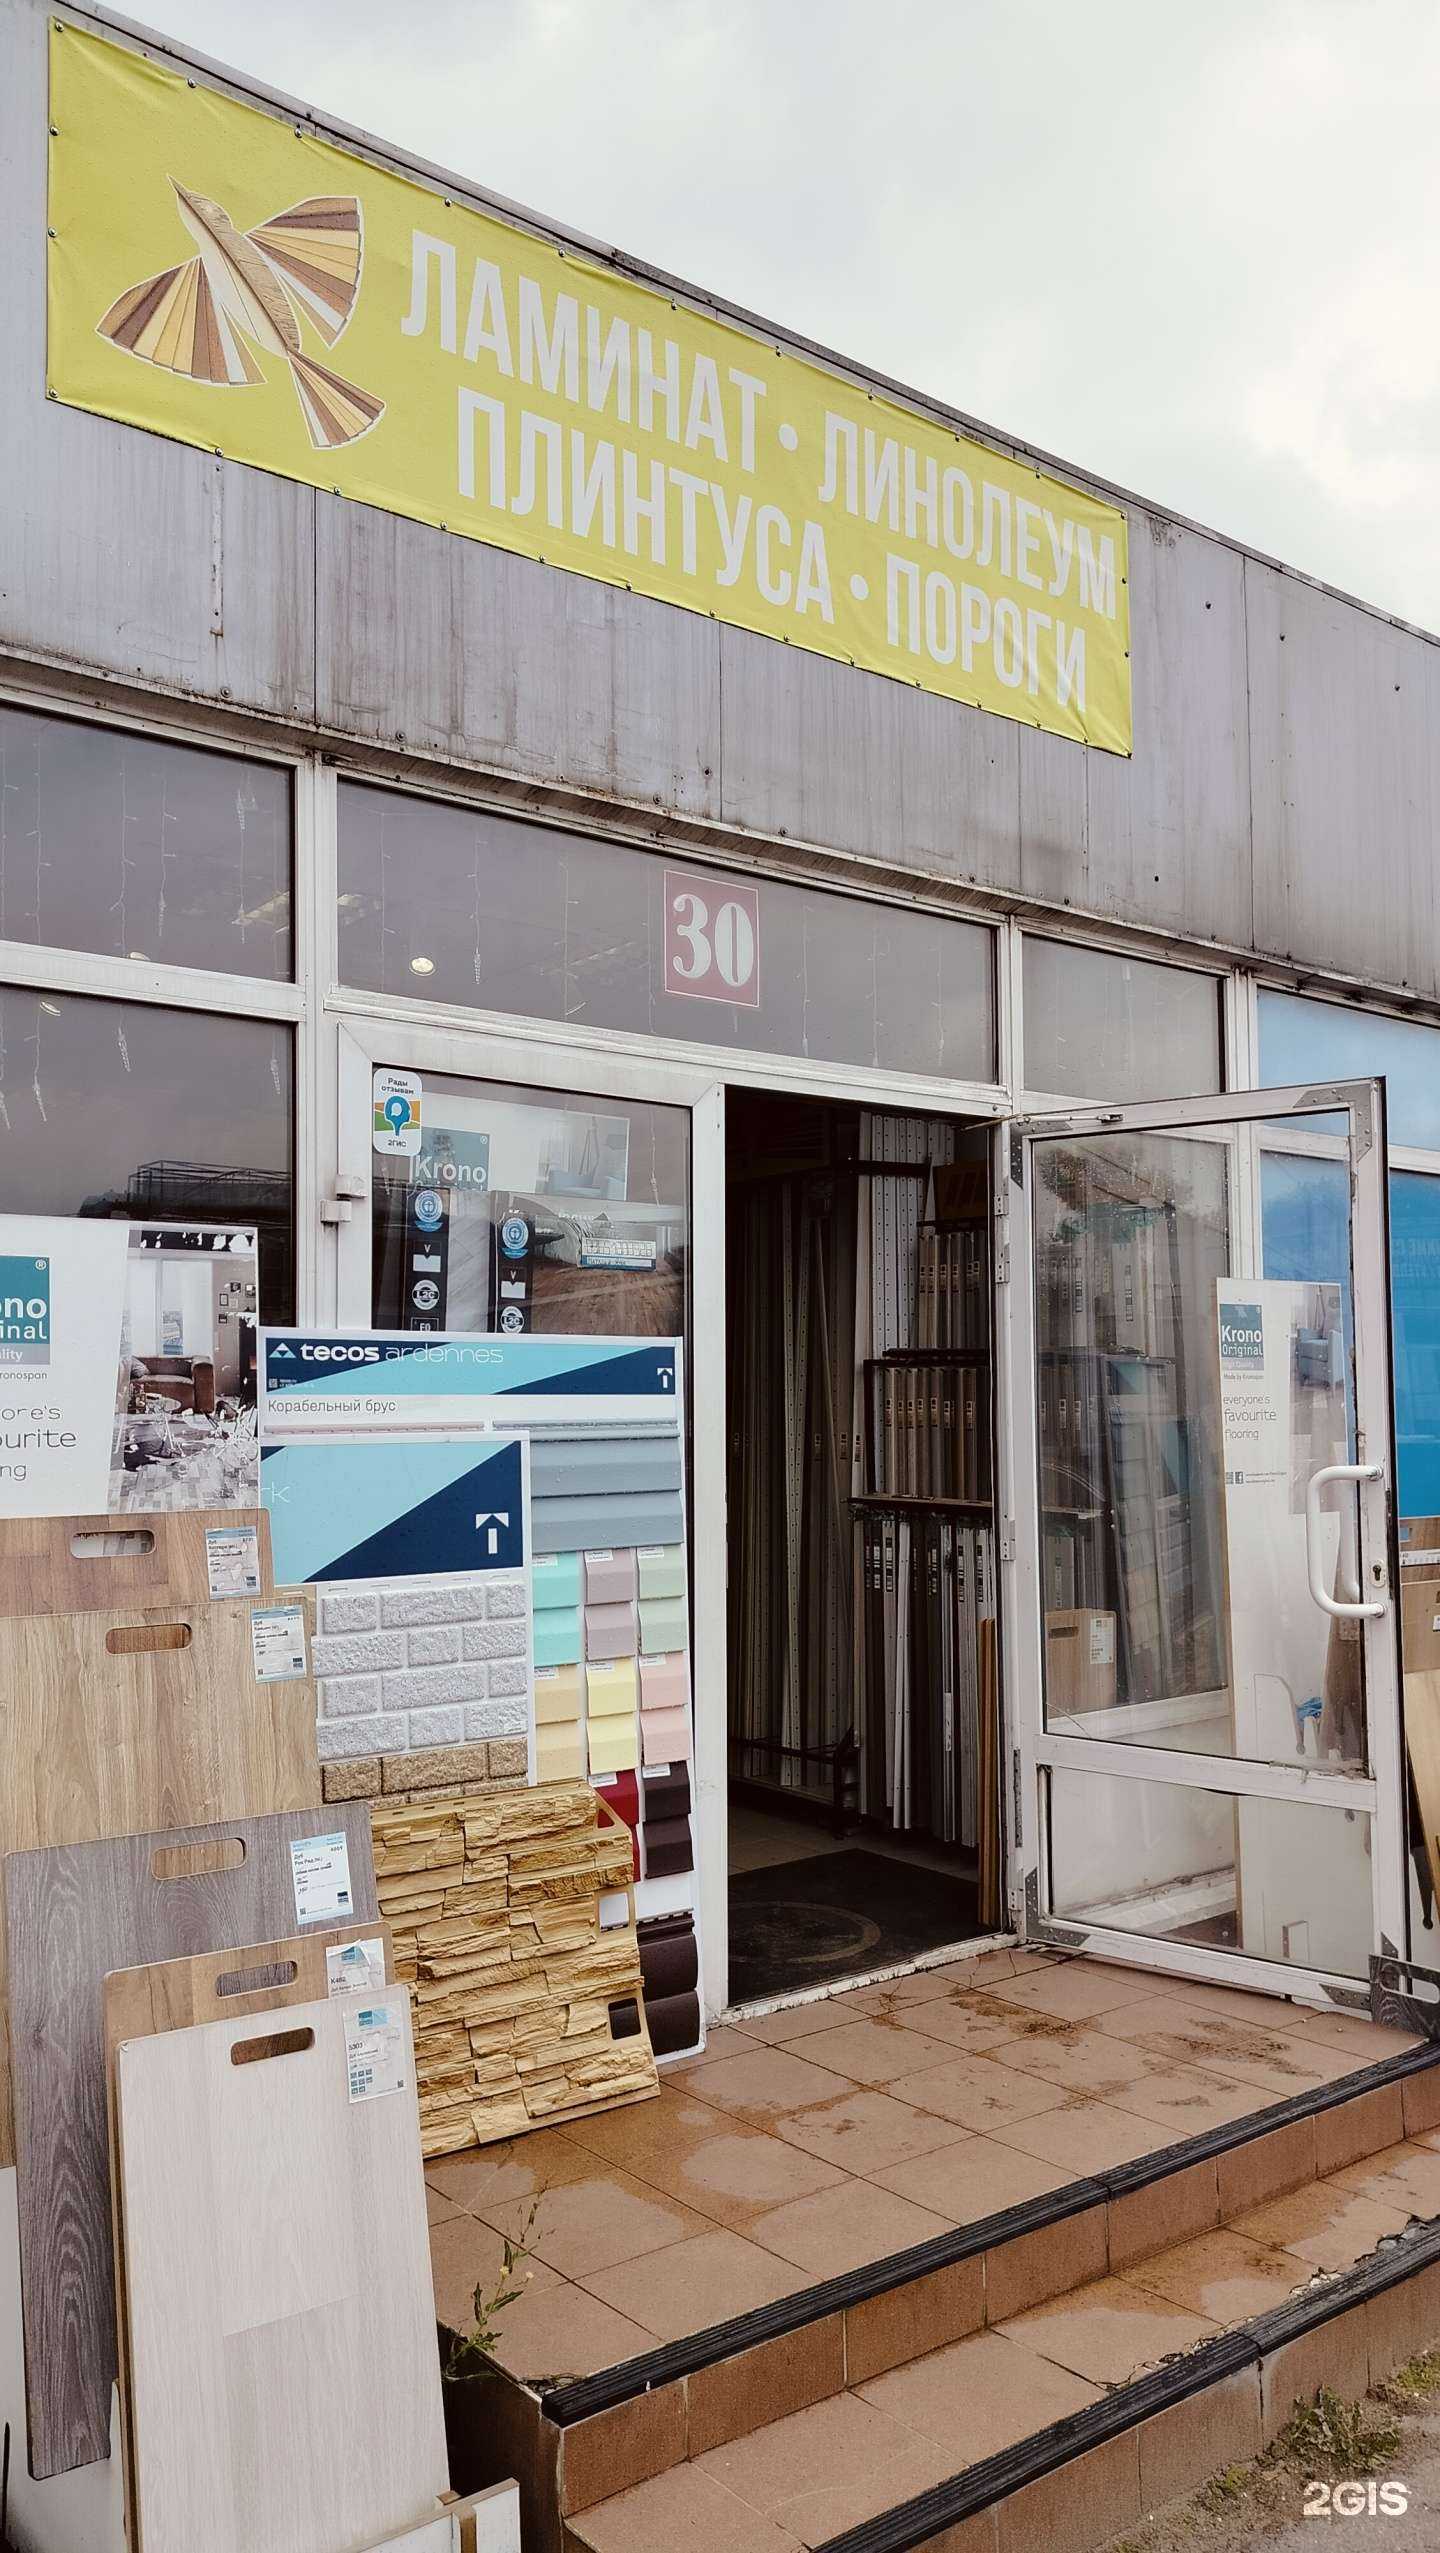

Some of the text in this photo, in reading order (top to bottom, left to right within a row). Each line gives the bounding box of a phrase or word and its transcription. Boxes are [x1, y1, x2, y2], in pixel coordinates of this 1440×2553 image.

[400, 229, 1116, 621] ЛАМИНАТ ЛИНОЛЕУМ
[457, 385, 1087, 713] ПЛИНТУСА ПОРОГИ
[673, 893, 755, 987] 30
[381, 1085, 415, 1095] отзывам
[388, 1077, 408, 1087] Рады
[387, 1139, 407, 1148] 2ГИС
[415, 1155, 487, 1183] Krono
[1221, 1325, 1262, 1343] Krono
[300, 1343, 504, 1364] tecos ardennes
[1222, 1343, 1264, 1358] Original
[268, 1399, 397, 1415] Корабельный брус
[1224, 1408, 1277, 1425] favourite
[0, 1428, 77, 1449] urite
